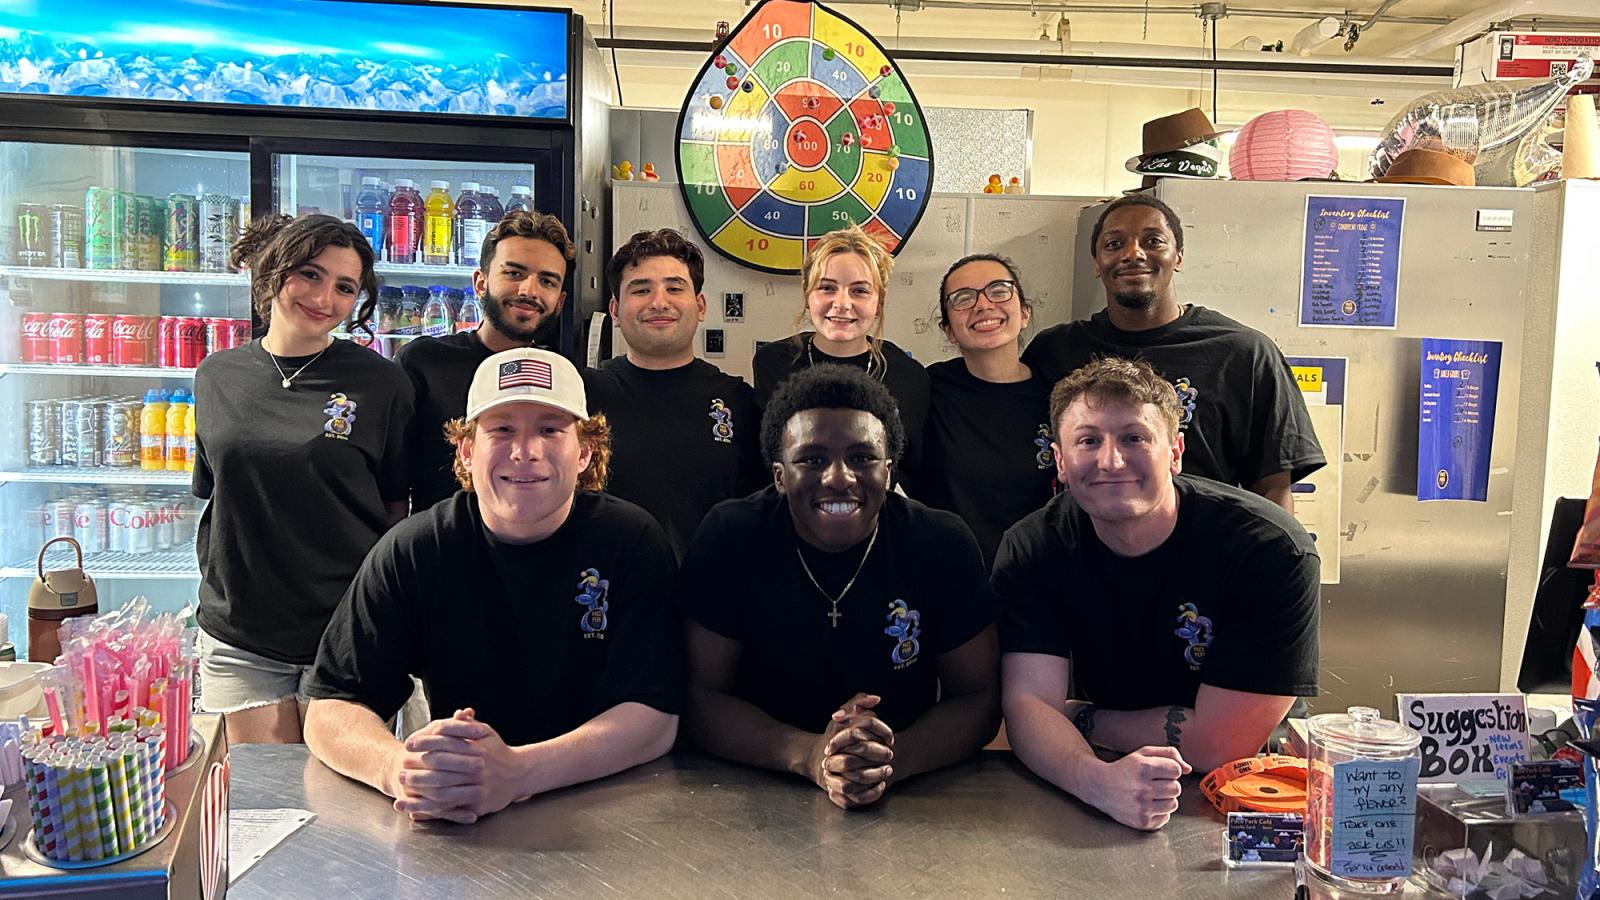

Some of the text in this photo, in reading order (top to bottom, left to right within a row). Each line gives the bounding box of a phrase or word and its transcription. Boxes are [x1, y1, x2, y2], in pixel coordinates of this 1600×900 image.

[762, 23, 783, 40] 10
[845, 42, 865, 57] 10
[776, 62, 791, 73] 30
[832, 70, 847, 81] 40
[894, 112, 914, 126] 10
[763, 139, 779, 150] 80
[797, 140, 818, 152] 100
[836, 143, 851, 154] 70
[867, 172, 883, 183] 20
[695, 182, 716, 195] 10
[800, 181, 815, 191] 60
[896, 187, 917, 200] 10
[764, 211, 780, 220] 40
[832, 211, 849, 221] 50
[1319, 208, 1390, 220] Inventory Checklist
[746, 239, 769, 251] 10
[1426, 350, 1488, 365] Inventory Checklist
[1296, 373, 1317, 382] ALS
[1408, 700, 1526, 747] Suggestion
[1233, 760, 1253, 770] ADMIT
[1239, 766, 1253, 774] ONE
[1345, 768, 1401, 782] Want to
[1348, 783, 1405, 797] try any
[1346, 841, 1372, 851] ask
